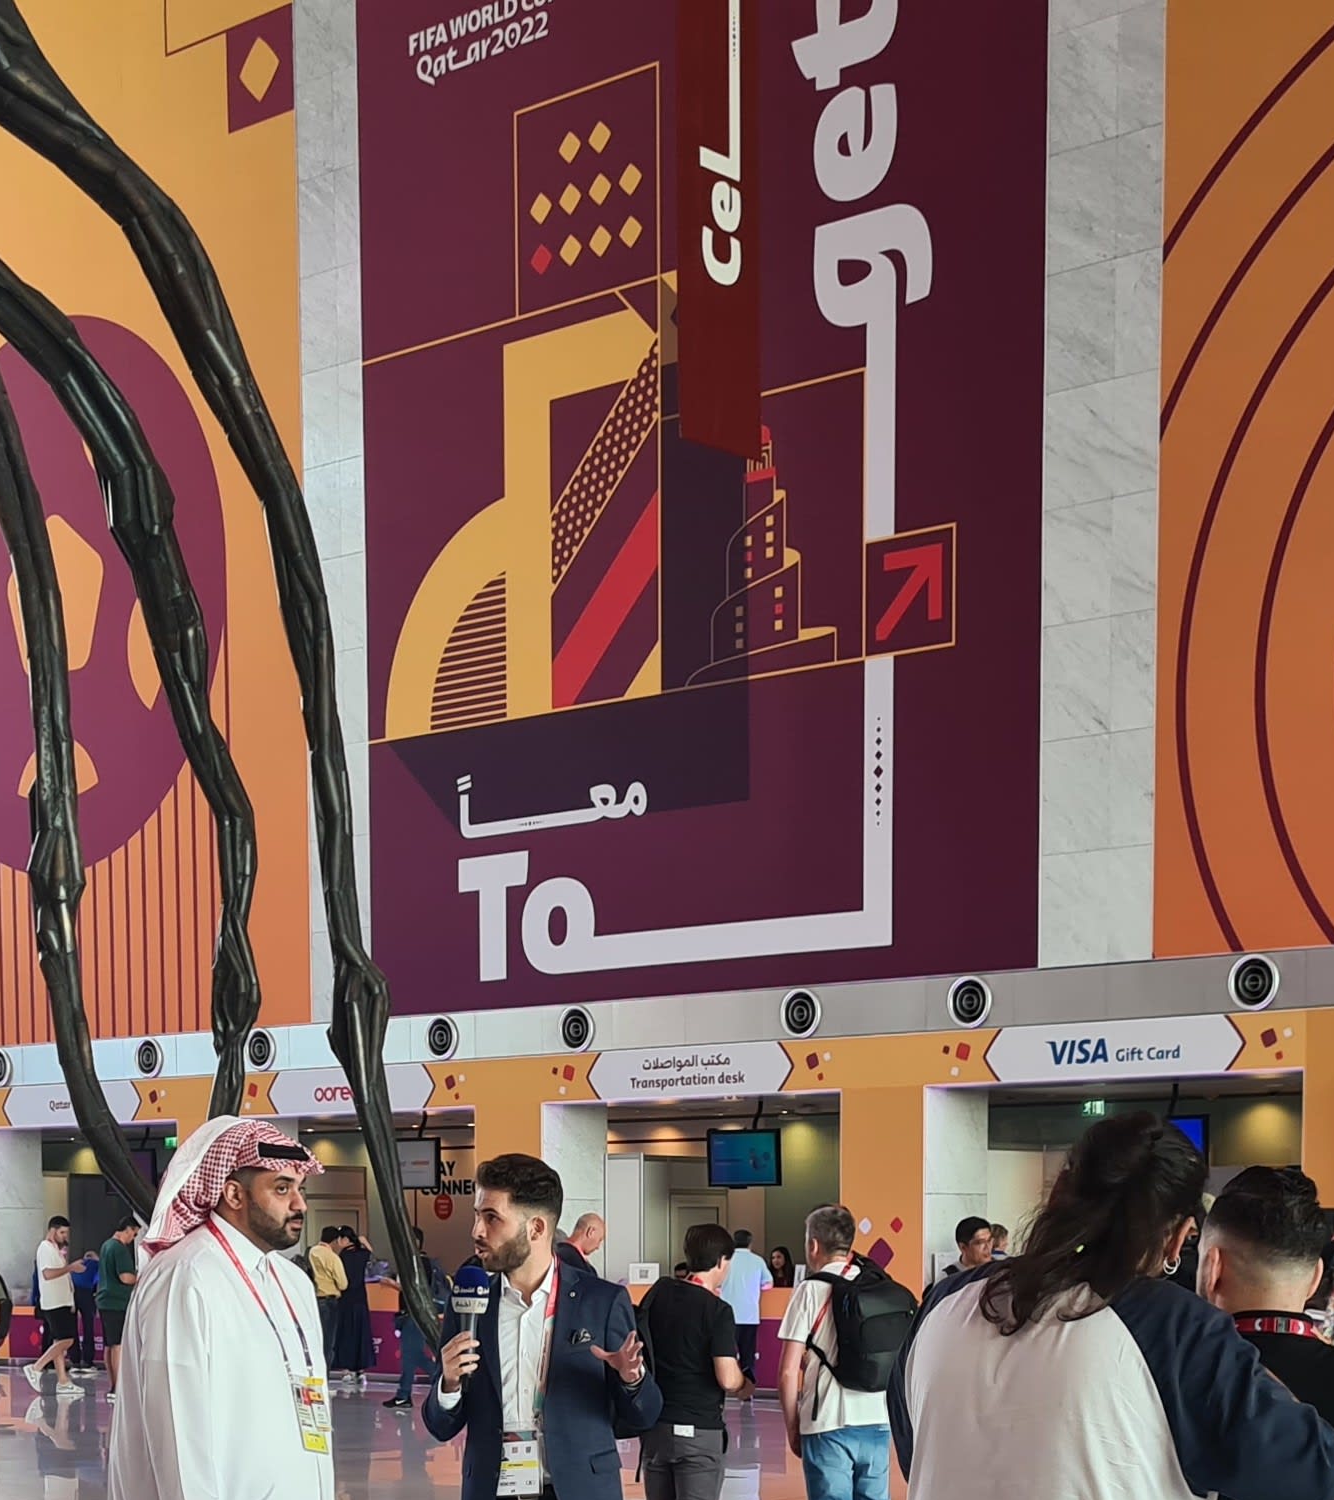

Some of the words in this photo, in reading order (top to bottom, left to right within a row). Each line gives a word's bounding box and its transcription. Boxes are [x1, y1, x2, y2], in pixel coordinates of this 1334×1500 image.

[408, 23, 449, 57] FIFA
[1045, 1038, 1109, 1065] VISA
[1115, 1047, 1144, 1061] Gift
[1147, 1044, 1181, 1060] Card
[642, 1055, 698, 1072] المواصلات
[701, 1053, 730, 1070] مكتب
[630, 1073, 715, 1090] Transportation
[717, 1071, 746, 1084] desk
